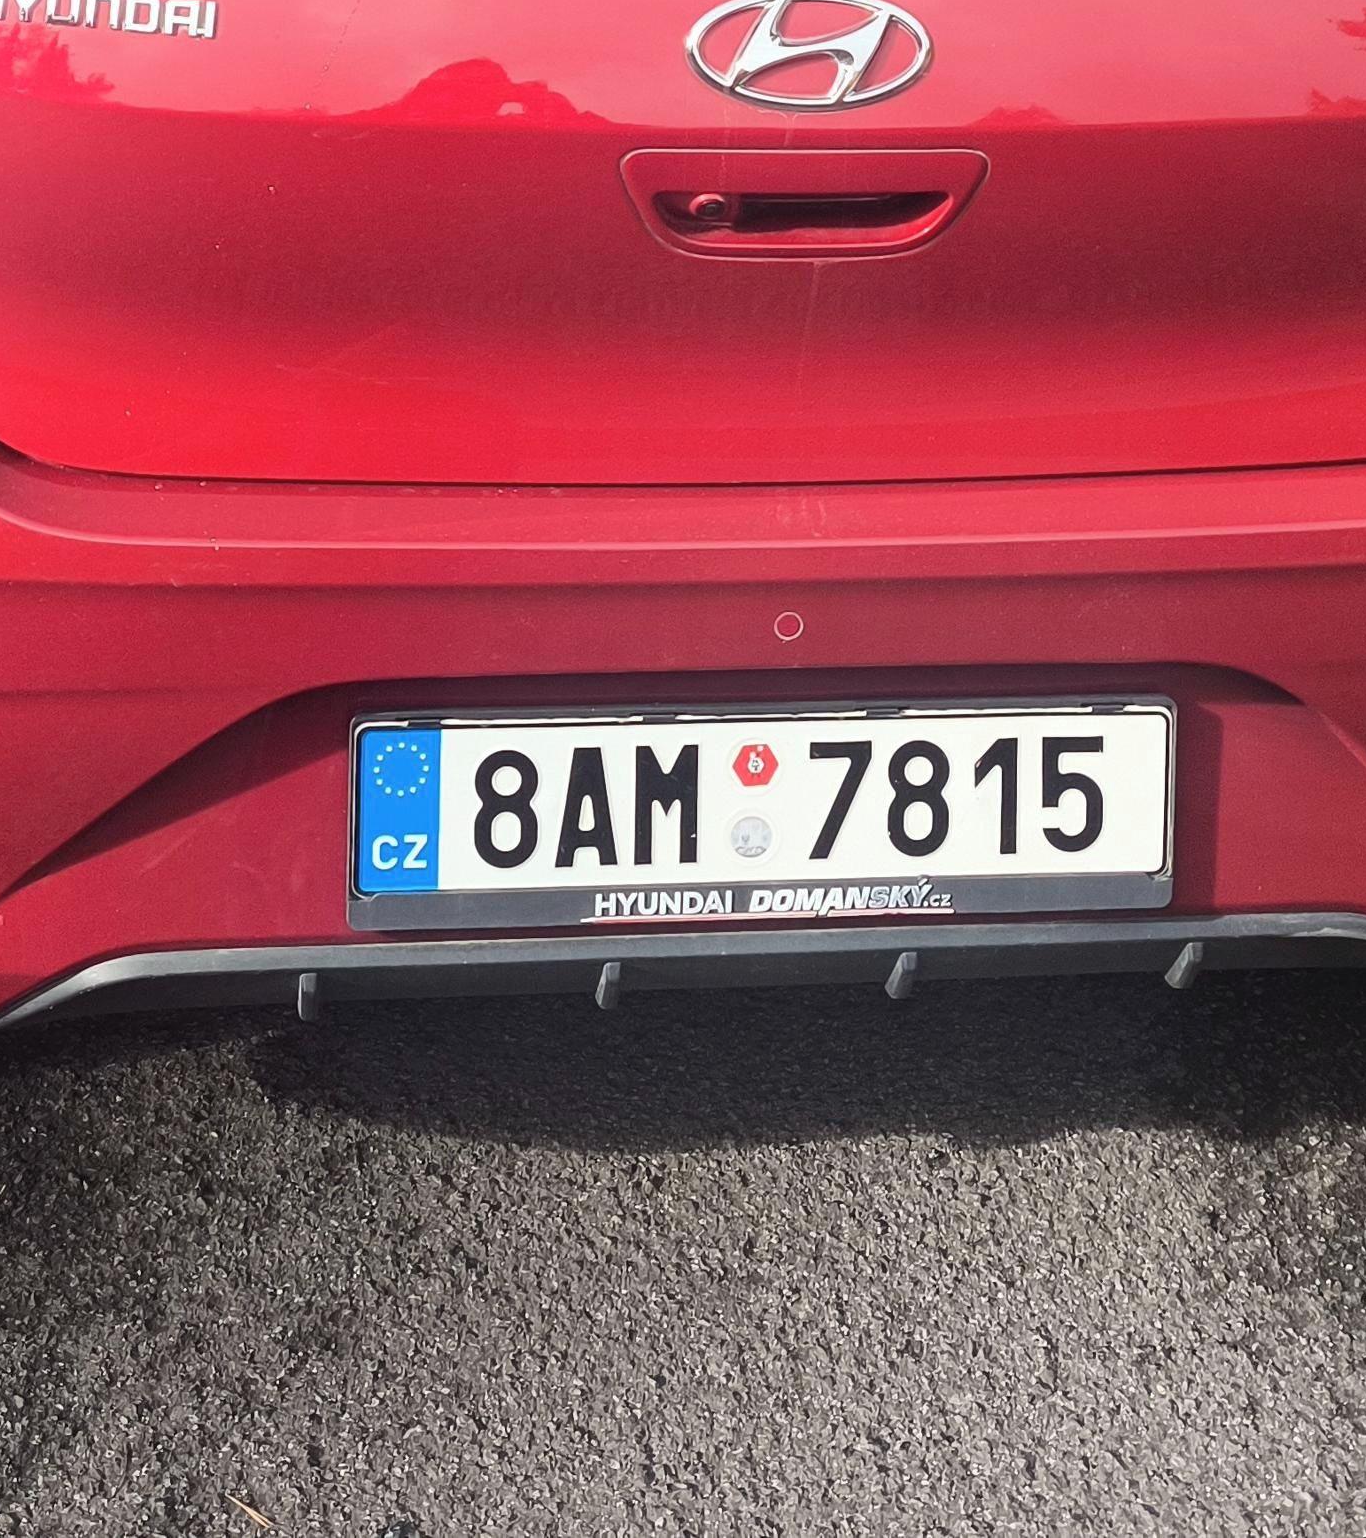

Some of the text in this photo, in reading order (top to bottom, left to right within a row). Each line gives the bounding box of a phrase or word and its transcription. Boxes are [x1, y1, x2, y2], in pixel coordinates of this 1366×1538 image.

[473, 736, 1105, 869] 8AM 7815
[371, 834, 428, 871] CZ
[593, 890, 734, 917] HYUNDAI
